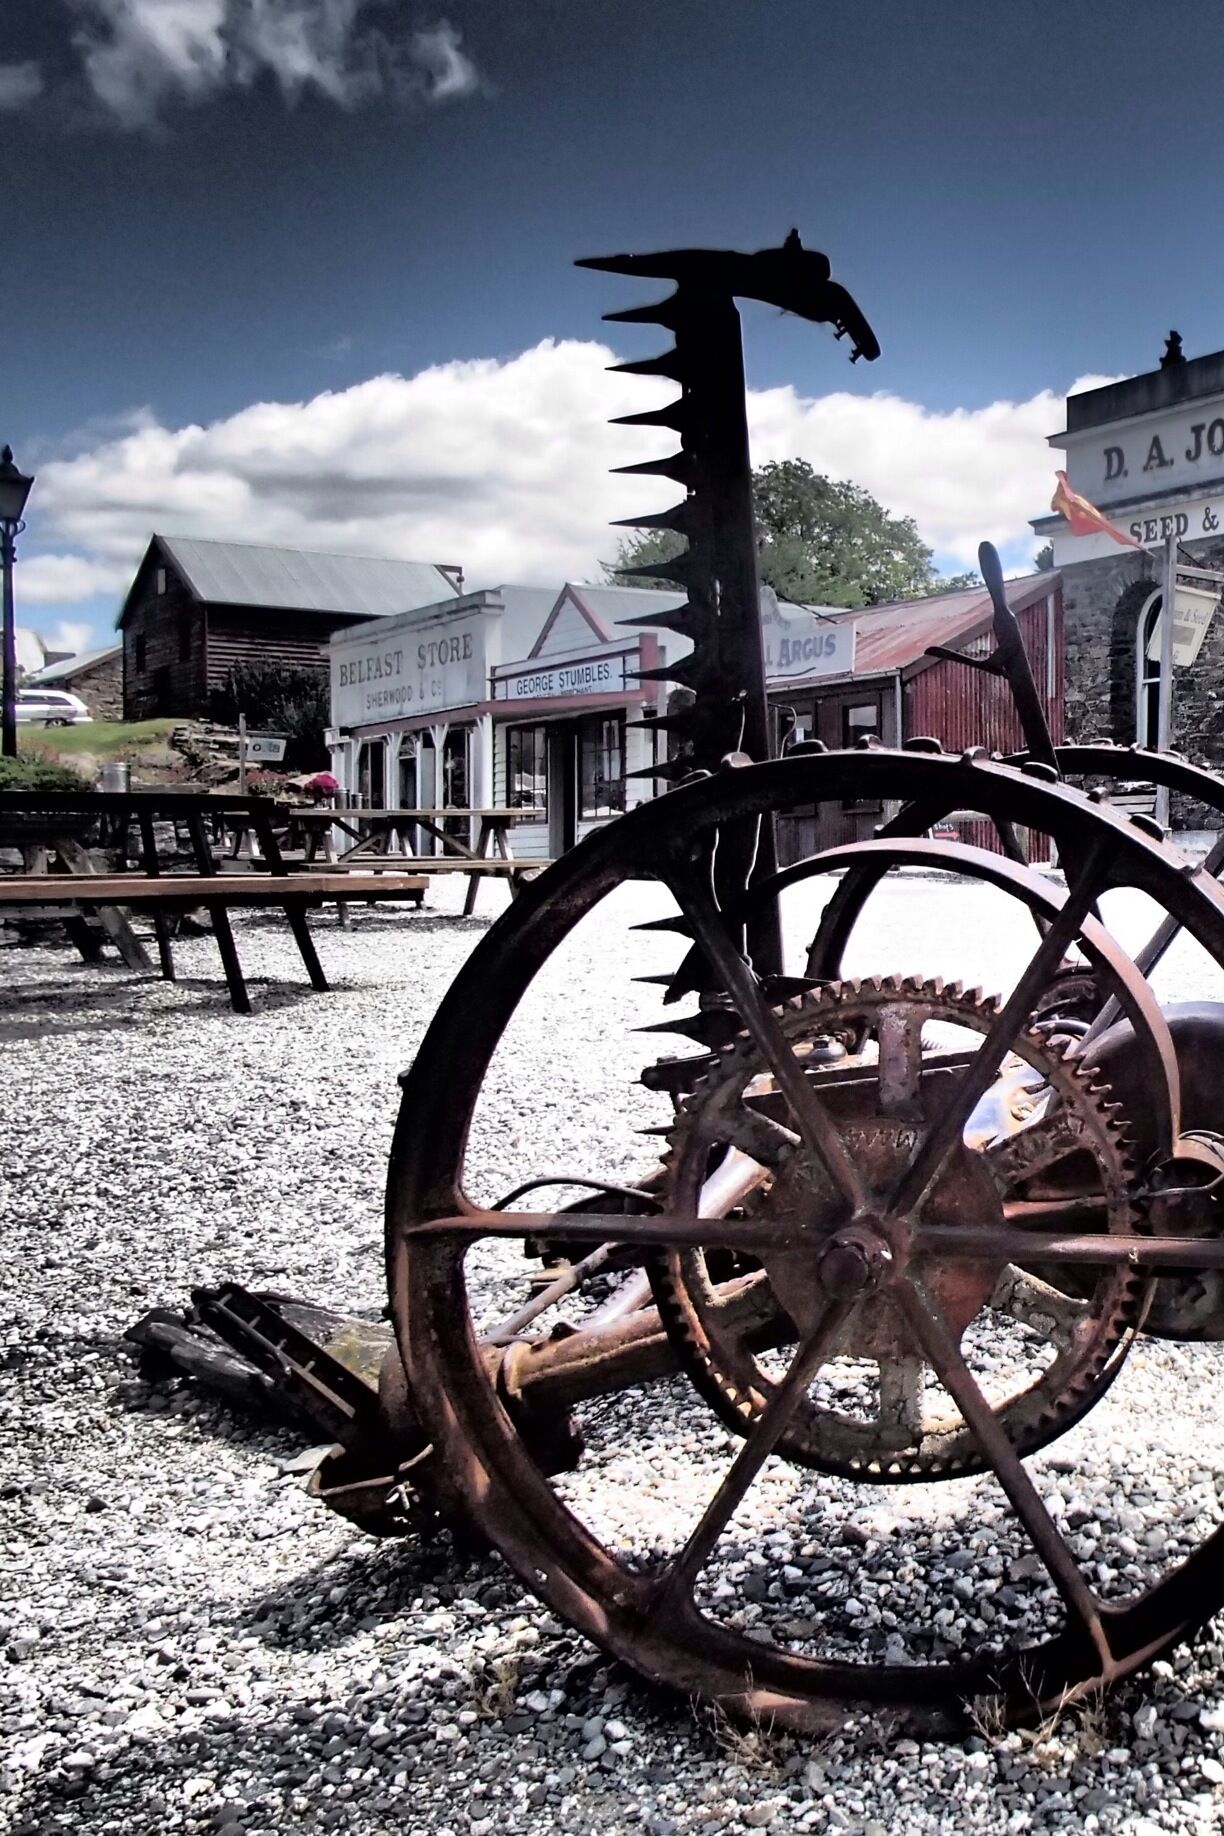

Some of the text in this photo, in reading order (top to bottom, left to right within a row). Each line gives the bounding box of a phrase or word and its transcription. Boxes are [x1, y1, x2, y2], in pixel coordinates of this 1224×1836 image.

[1104, 446, 1128, 481] D.
[1143, 435, 1174, 472] A.
[1130, 512, 1188, 543] SEED
[1203, 507, 1219, 532] &
[340, 634, 473, 687] BELFAST STORE
[777, 634, 836, 667] ARGUS
[366, 685, 413, 709] SHERWOOD
[517, 674, 553, 695] GEORGE
